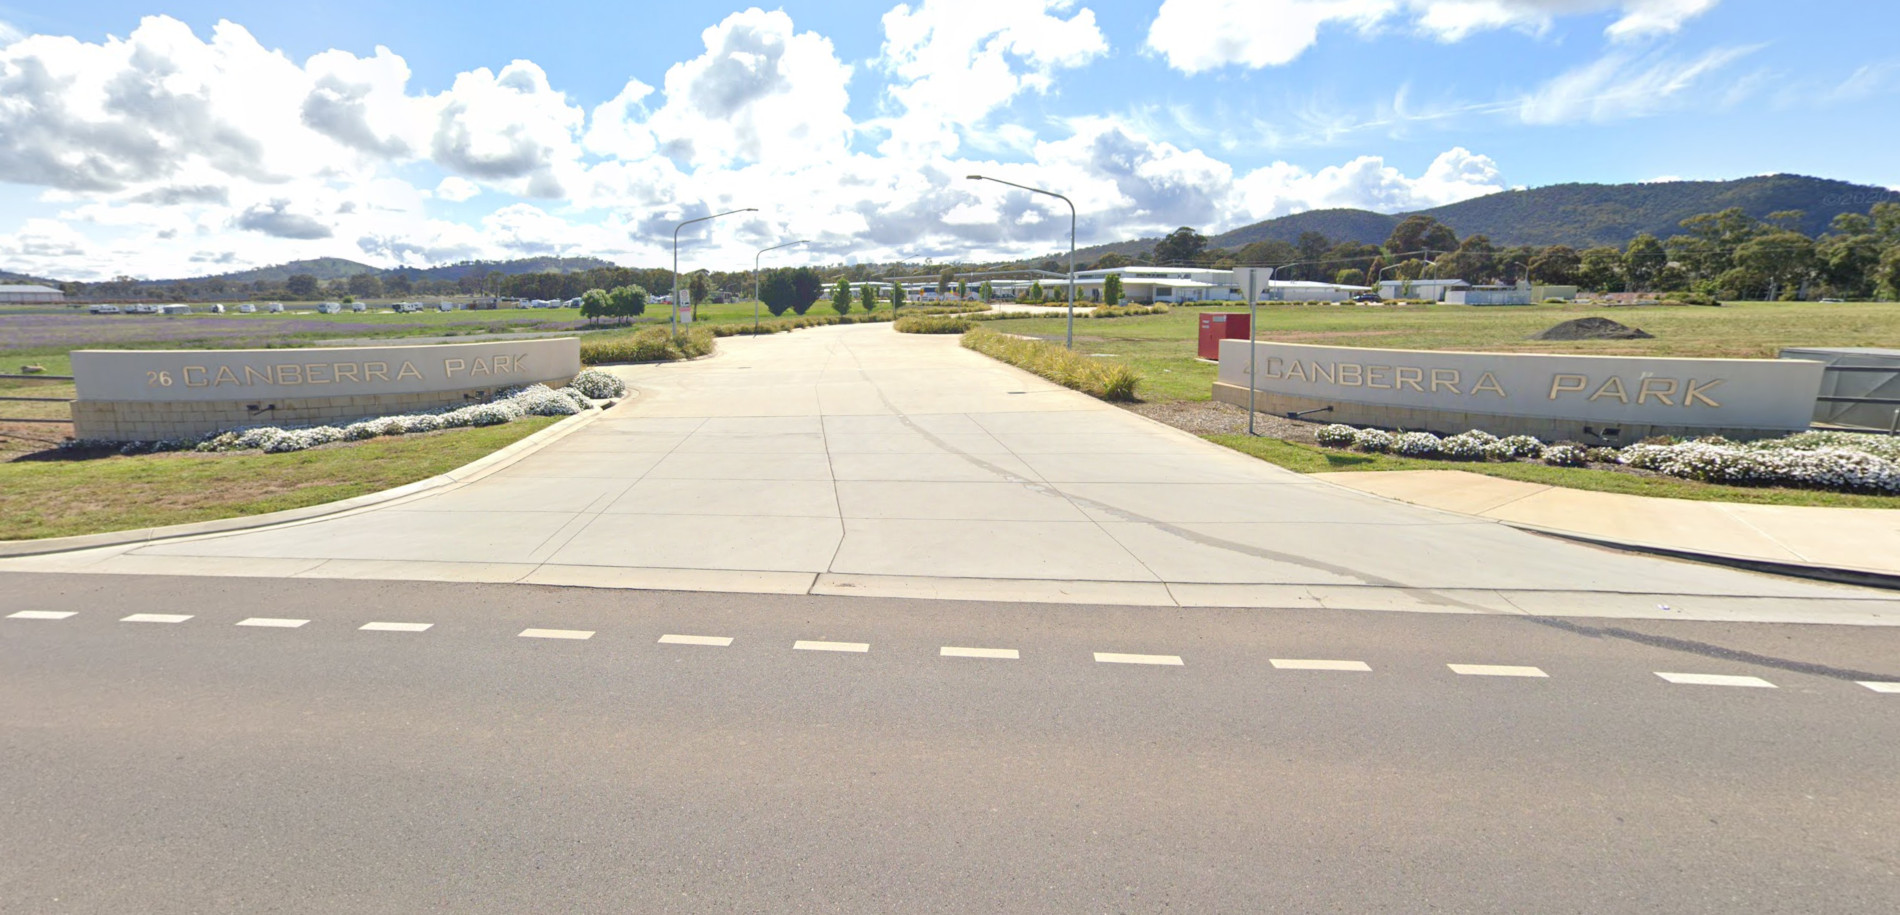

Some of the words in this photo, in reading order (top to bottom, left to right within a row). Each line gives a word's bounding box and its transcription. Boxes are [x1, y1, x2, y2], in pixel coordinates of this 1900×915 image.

[146, 370, 173, 387] 26
[182, 360, 424, 388] CANBERRA
[444, 353, 529, 378] PARK
[1265, 356, 1507, 398] CANBERRA
[1548, 373, 1726, 407] PARK
